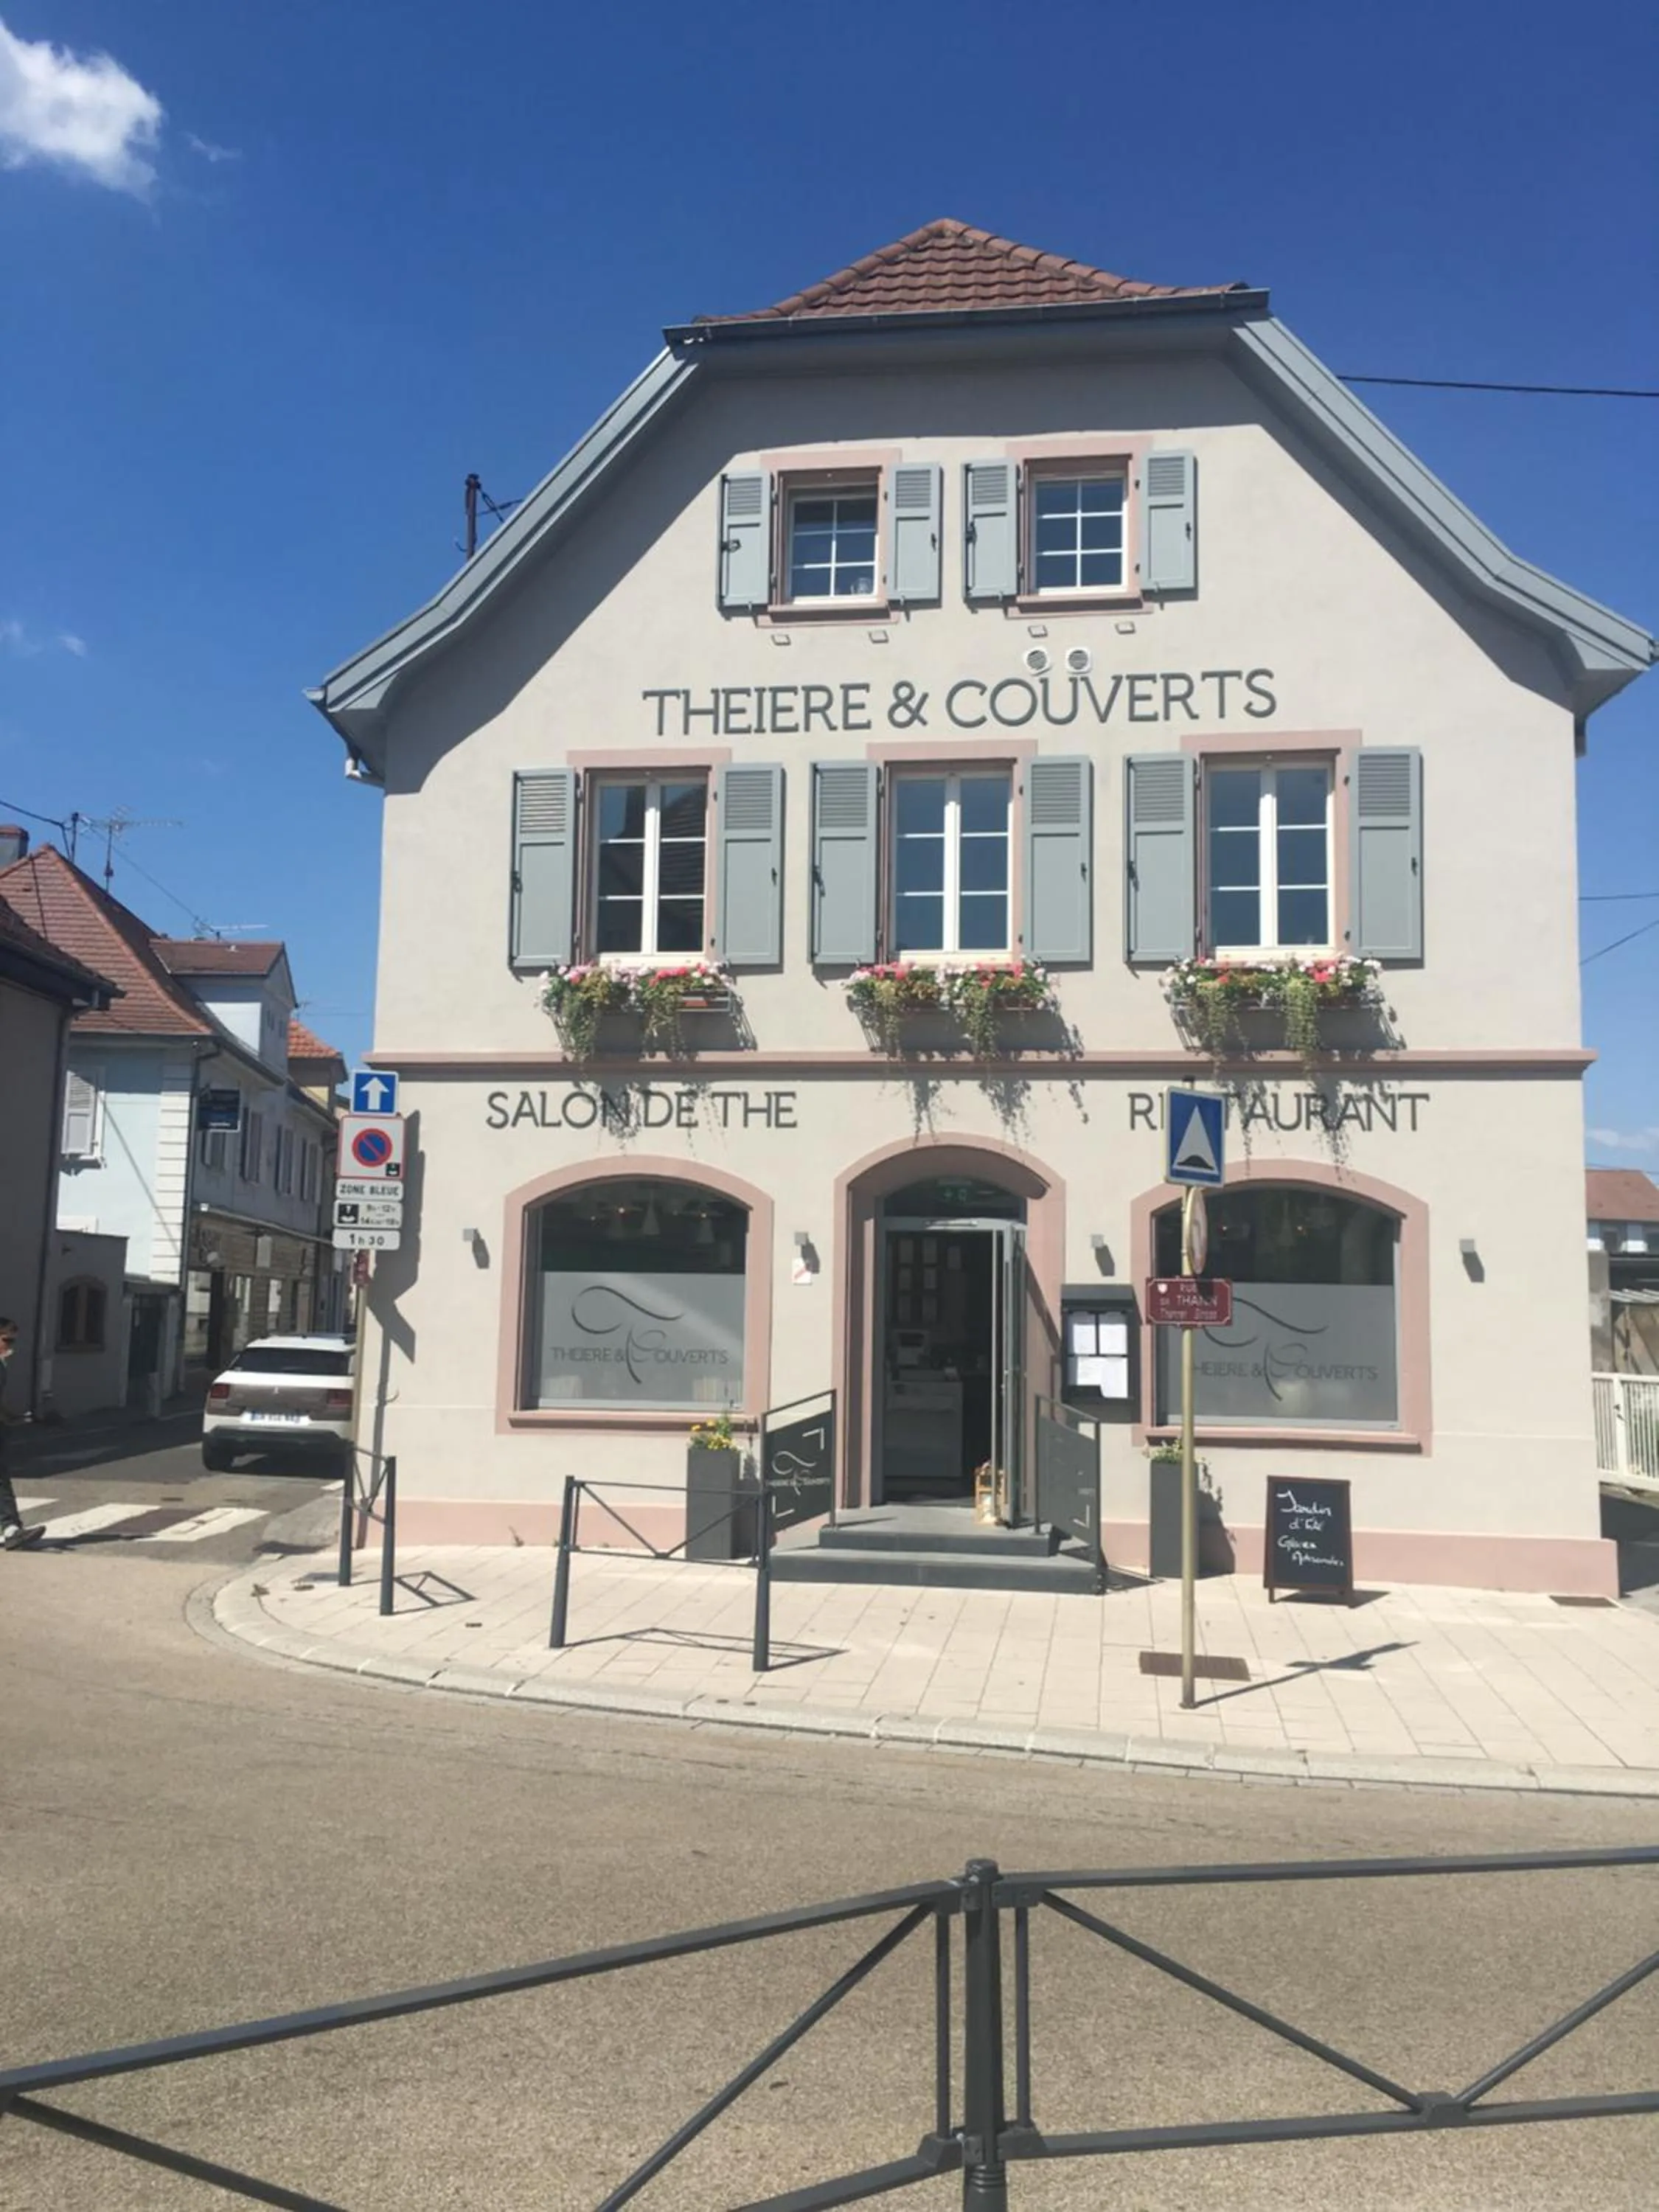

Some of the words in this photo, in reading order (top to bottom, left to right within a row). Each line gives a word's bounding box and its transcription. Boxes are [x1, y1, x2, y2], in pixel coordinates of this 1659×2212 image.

[642, 681, 871, 736] THEIERE
[887, 679, 929, 728] &
[945, 667, 1278, 728] COUVERTS
[486, 1091, 632, 1129] SALON
[641, 1091, 699, 1129] DE
[709, 1091, 798, 1129] THE
[1127, 1092, 1430, 1133] RTAURANT
[340, 1184, 366, 1194] ZONE
[369, 1185, 400, 1196] BLEUE
[1192, 1362, 1248, 1377] HEIERE
